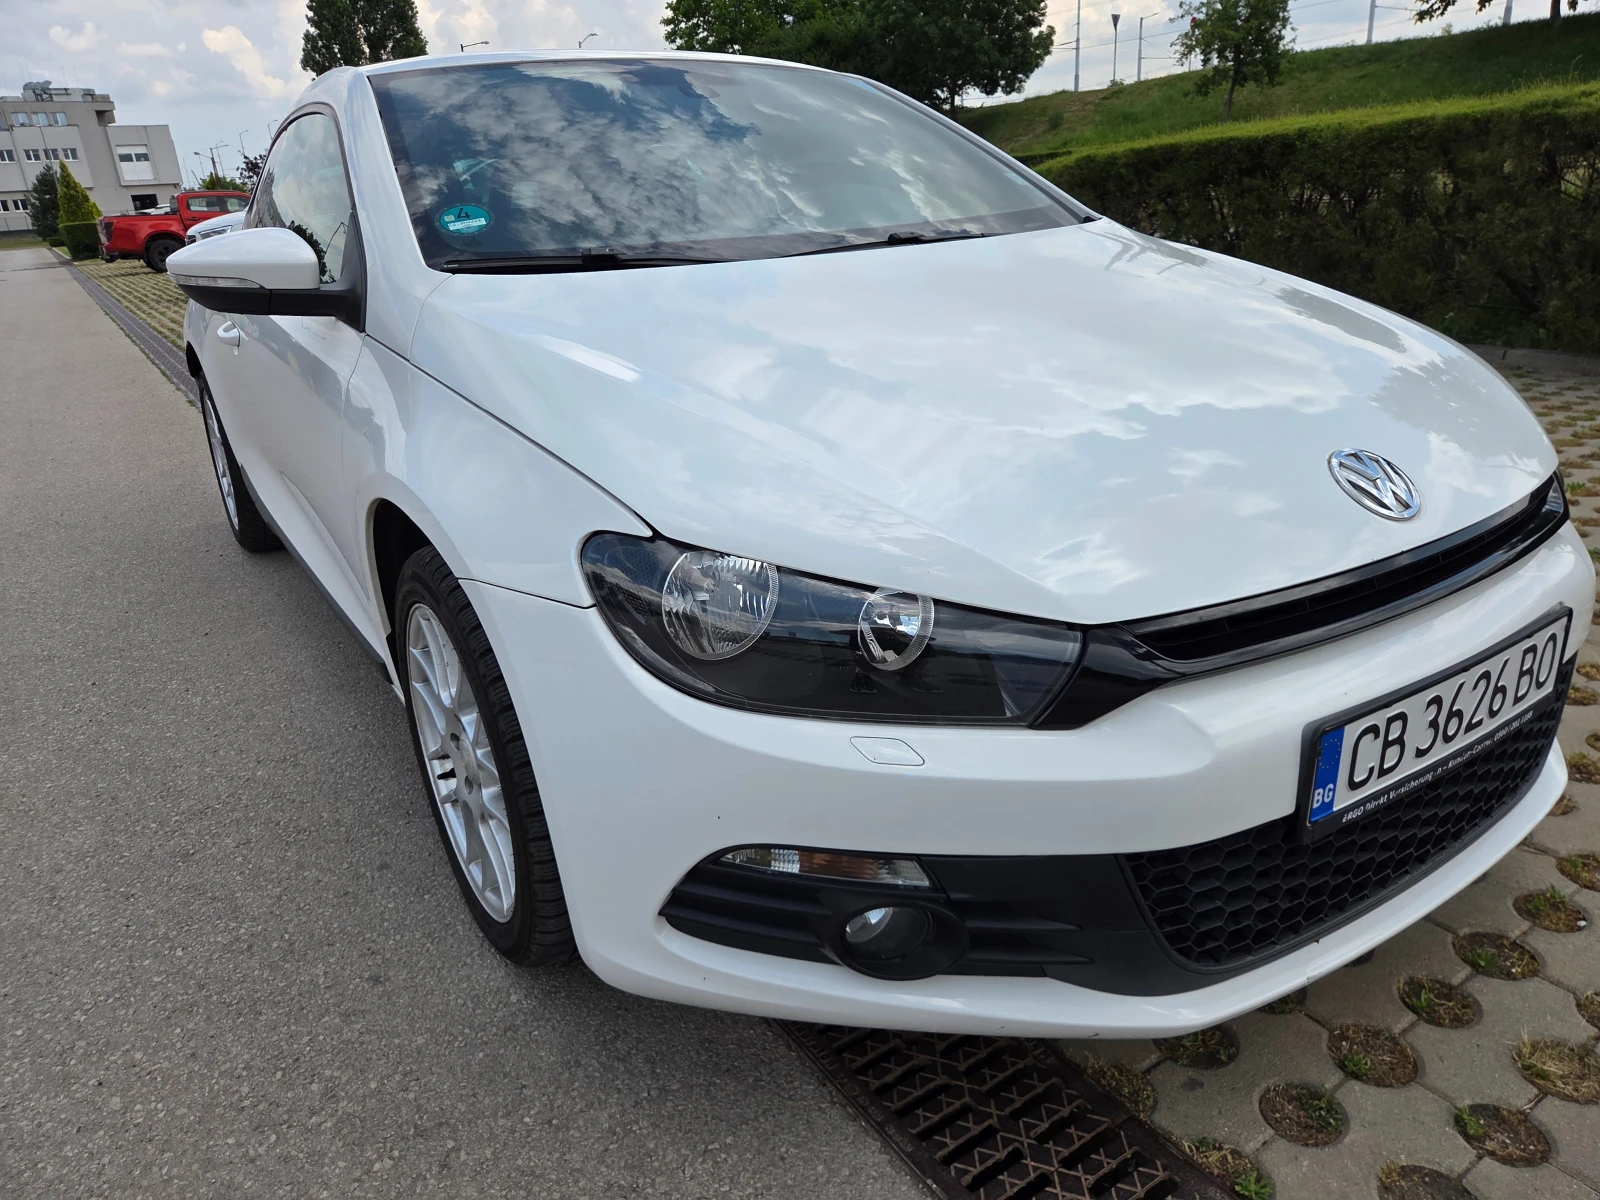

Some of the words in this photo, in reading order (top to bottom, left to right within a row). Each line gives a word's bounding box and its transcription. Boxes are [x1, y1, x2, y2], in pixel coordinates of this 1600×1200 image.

[457, 207, 471, 219] 4
[1348, 710, 1408, 791] CB
[1414, 656, 1511, 759] 3626
[1513, 631, 1558, 707] BO
[1312, 783, 1335, 809] BG
[1390, 767, 1442, 799] Vrsicherungn
